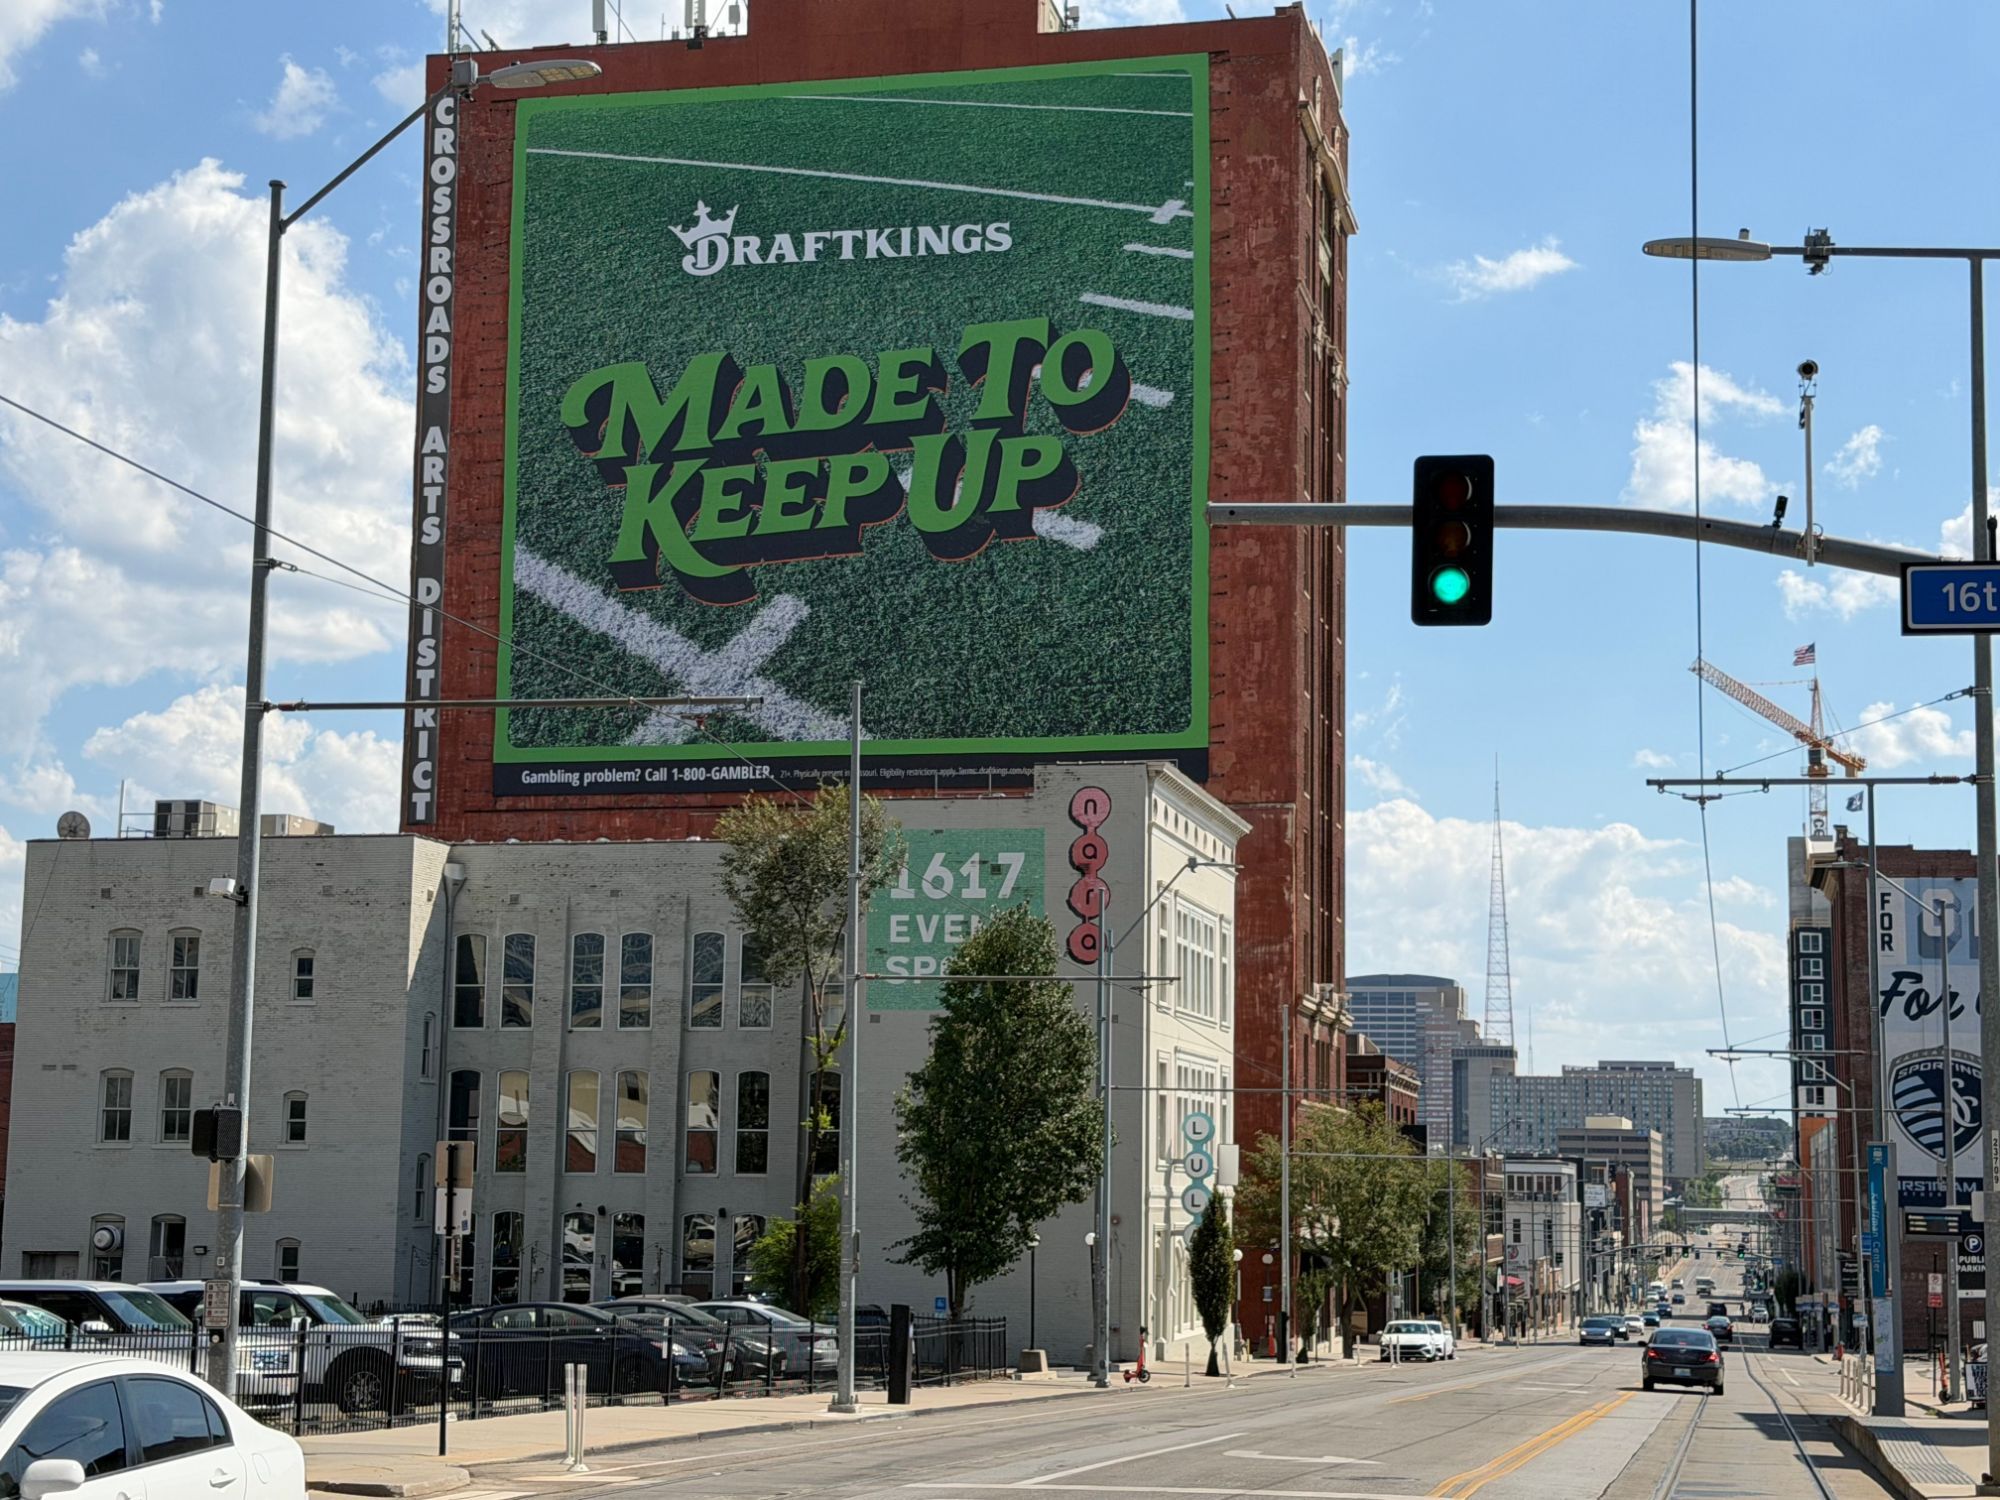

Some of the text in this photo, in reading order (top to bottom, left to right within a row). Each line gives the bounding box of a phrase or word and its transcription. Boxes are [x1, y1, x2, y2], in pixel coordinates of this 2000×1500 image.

[682, 221, 1013, 277] DRAFTKINGS
[560, 317, 1116, 460] MADE TO
[411, 97, 456, 821] CROSSROADS ARTS DISTRICT
[607, 428, 1064, 579] KEEP UP
[1941, 581, 1997, 612] 16t
[521, 770, 580, 787] Gambling
[583, 768, 640, 787] problem?
[645, 767, 667, 782] Call
[671, 765, 775, 782] 1-800-GAMBLER.
[890, 851, 1026, 900] 1617
[1080, 798, 1098, 951] nara
[1880, 892, 1894, 952] FOR
[886, 955, 950, 985] SP
